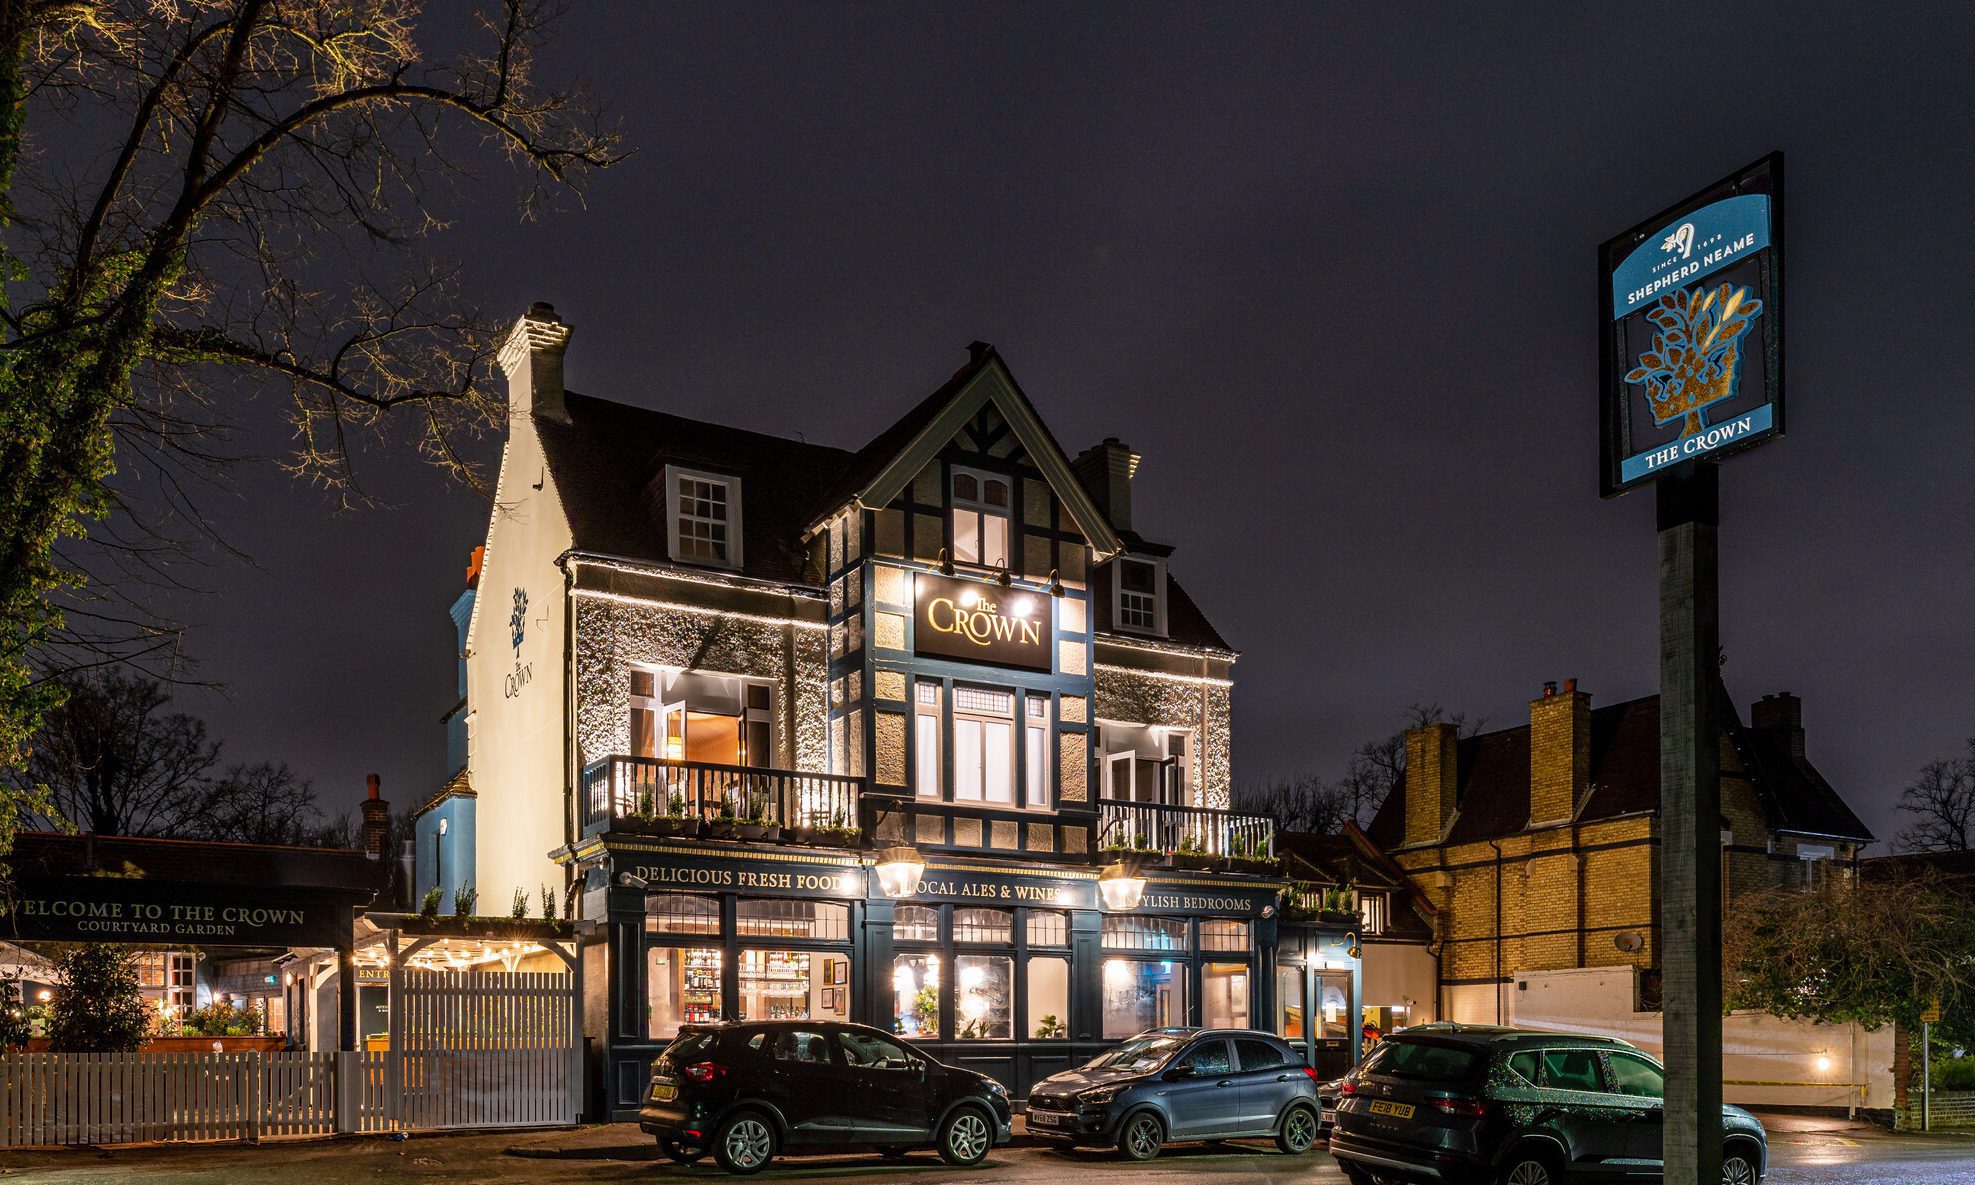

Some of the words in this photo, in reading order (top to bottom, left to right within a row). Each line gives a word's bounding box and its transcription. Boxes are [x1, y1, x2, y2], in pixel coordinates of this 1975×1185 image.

[1652, 256, 1677, 273] SINCE
[1697, 234, 1722, 250] 1698
[1628, 261, 1699, 304] SHEPHERD
[1704, 232, 1754, 267] NEAME
[1645, 445, 1679, 469] THE
[1683, 417, 1751, 454] CROWN
[977, 597, 996, 613] The
[928, 597, 1041, 646] CROWN
[636, 866, 732, 885] DELICIOUS
[738, 872, 791, 888] FRESH
[912, 880, 957, 895] OCAL
[961, 883, 995, 898] ALES
[1001, 885, 1011, 898] &
[1014, 885, 1061, 900] WINES
[131, 903, 162, 919] TO
[170, 905, 214, 921] THE
[222, 907, 304, 927] CROWN
[1183, 897, 1251, 911] BEDROOMS
[78, 920, 170, 934] COURTYARD
[175, 923, 235, 936] GARDEN
[1372, 1101, 1392, 1113] FE18
[1394, 1105, 1411, 1117] YUB
